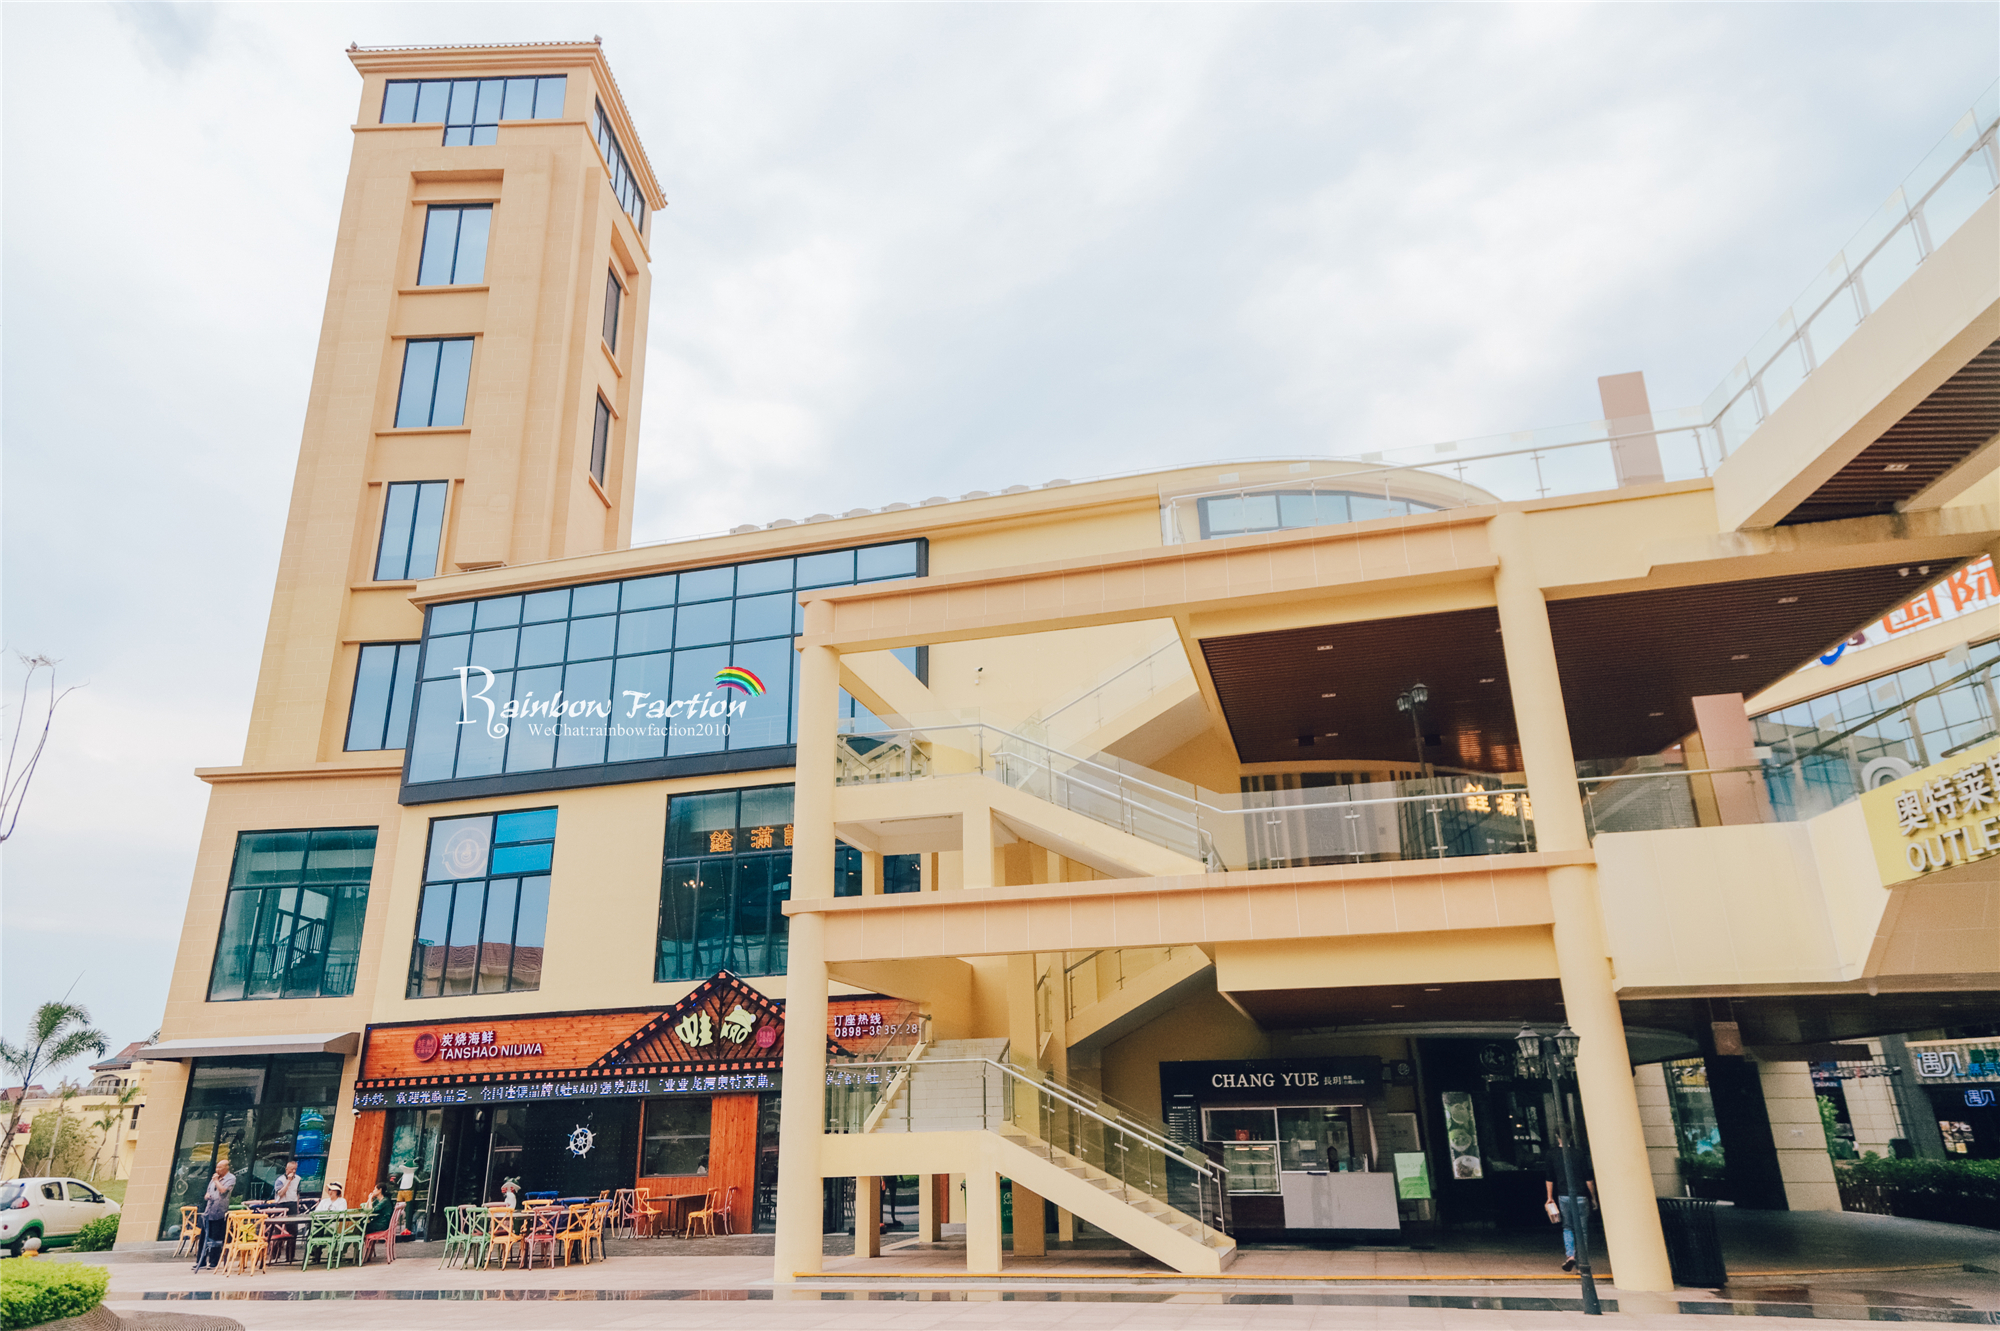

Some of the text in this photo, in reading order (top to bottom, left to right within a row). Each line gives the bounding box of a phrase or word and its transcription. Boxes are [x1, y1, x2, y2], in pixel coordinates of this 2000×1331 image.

[1906, 815, 2000, 872] OUTLE
[833, 1012, 882, 1027] 订座热线
[440, 1030, 494, 1047] 炭烧海鲜
[440, 1045, 499, 1060] TANSHAO
[500, 1043, 543, 1056] NIUWA
[1211, 1073, 1276, 1088] CHANG
[1281, 1072, 1320, 1087] YUE
